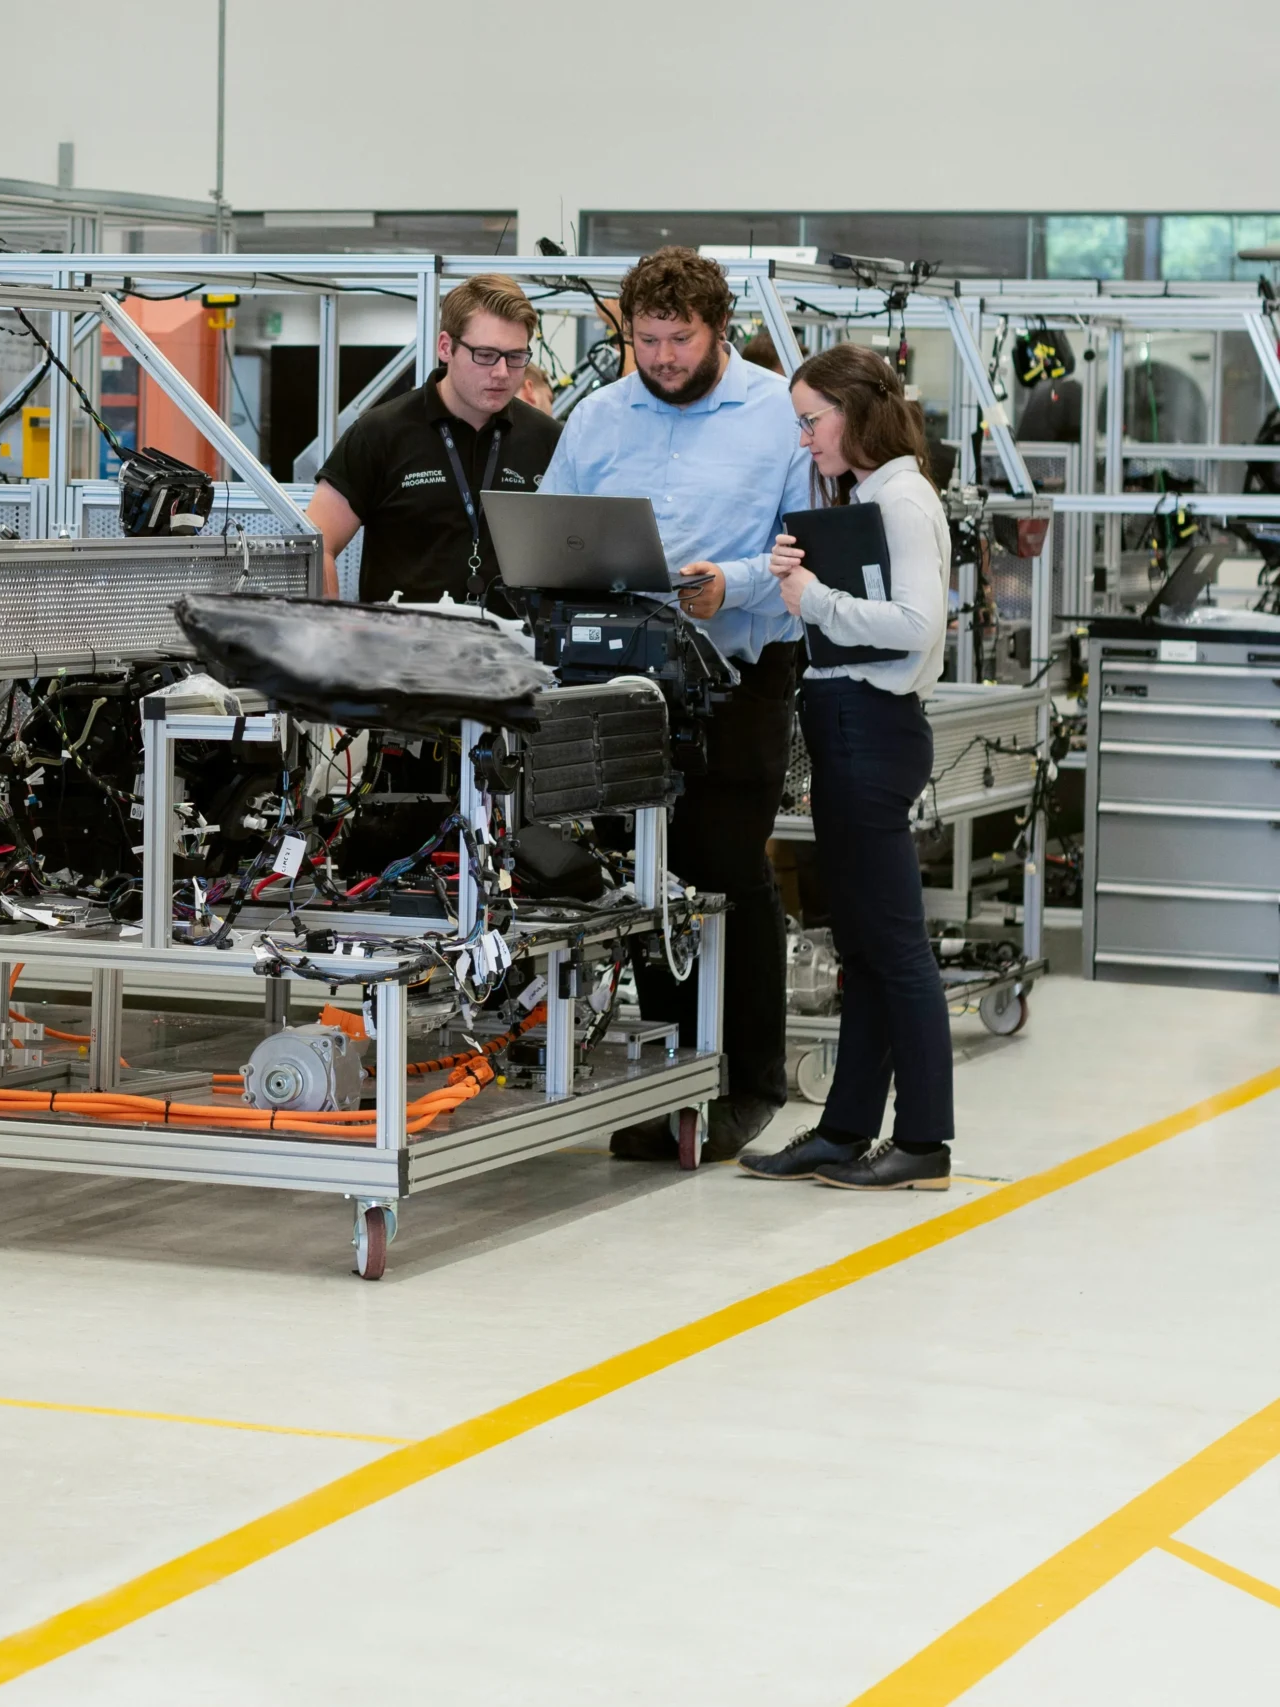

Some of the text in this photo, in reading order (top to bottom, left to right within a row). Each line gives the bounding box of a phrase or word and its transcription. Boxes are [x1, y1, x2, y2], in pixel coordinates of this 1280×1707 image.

[404, 470, 443, 481] APPRENTICE
[501, 476, 525, 484] JAGUAR
[401, 476, 447, 488] PROGRAMME
